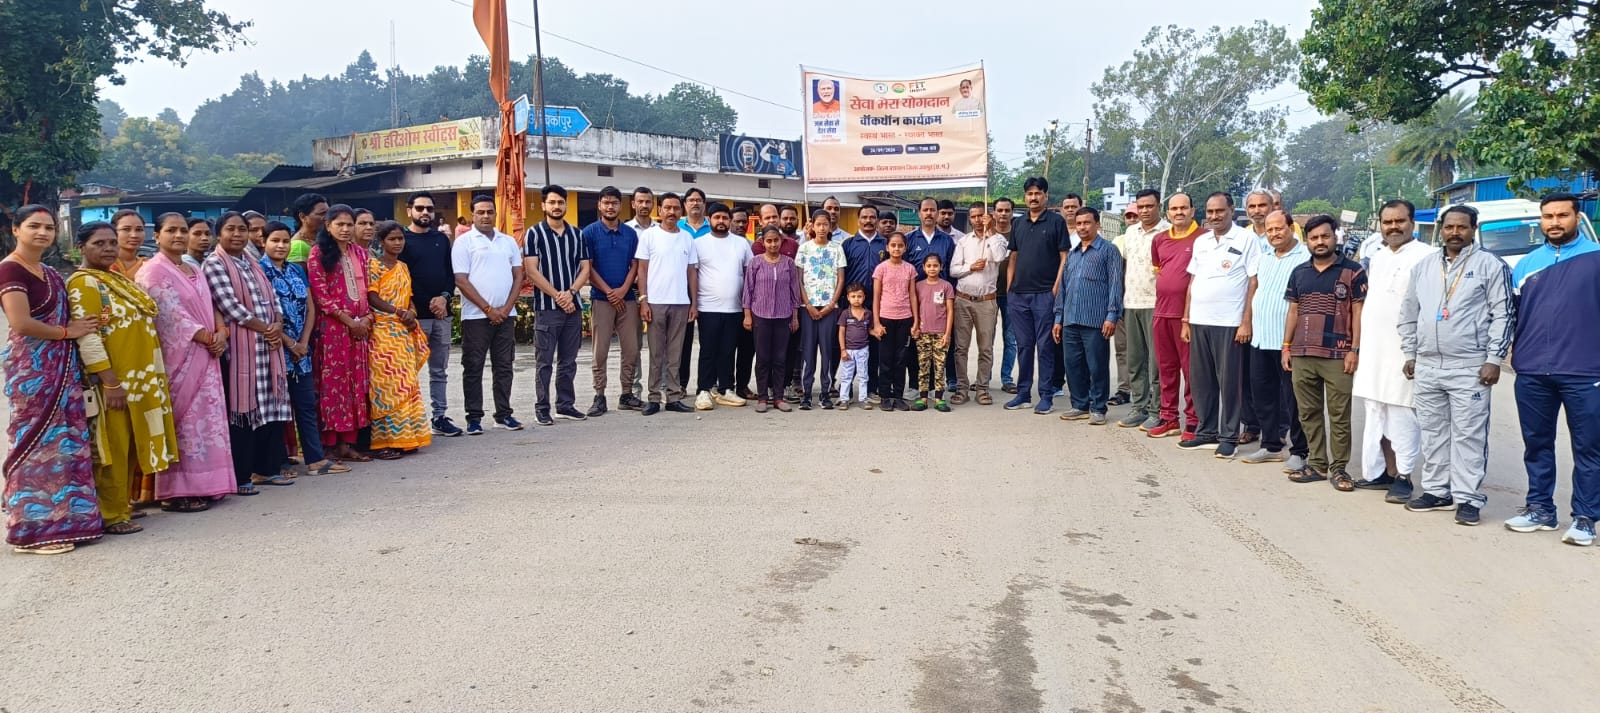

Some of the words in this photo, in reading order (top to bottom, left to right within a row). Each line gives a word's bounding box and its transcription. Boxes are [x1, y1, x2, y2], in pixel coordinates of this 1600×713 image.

[850, 96, 875, 110] सेवा
[901, 95, 950, 108] योगदान
[902, 113, 942, 126] कार्यक्रम
[369, 132, 381, 151] श्री
[383, 129, 421, 149] हरिओम
[423, 124, 458, 146] स्वीट्स
